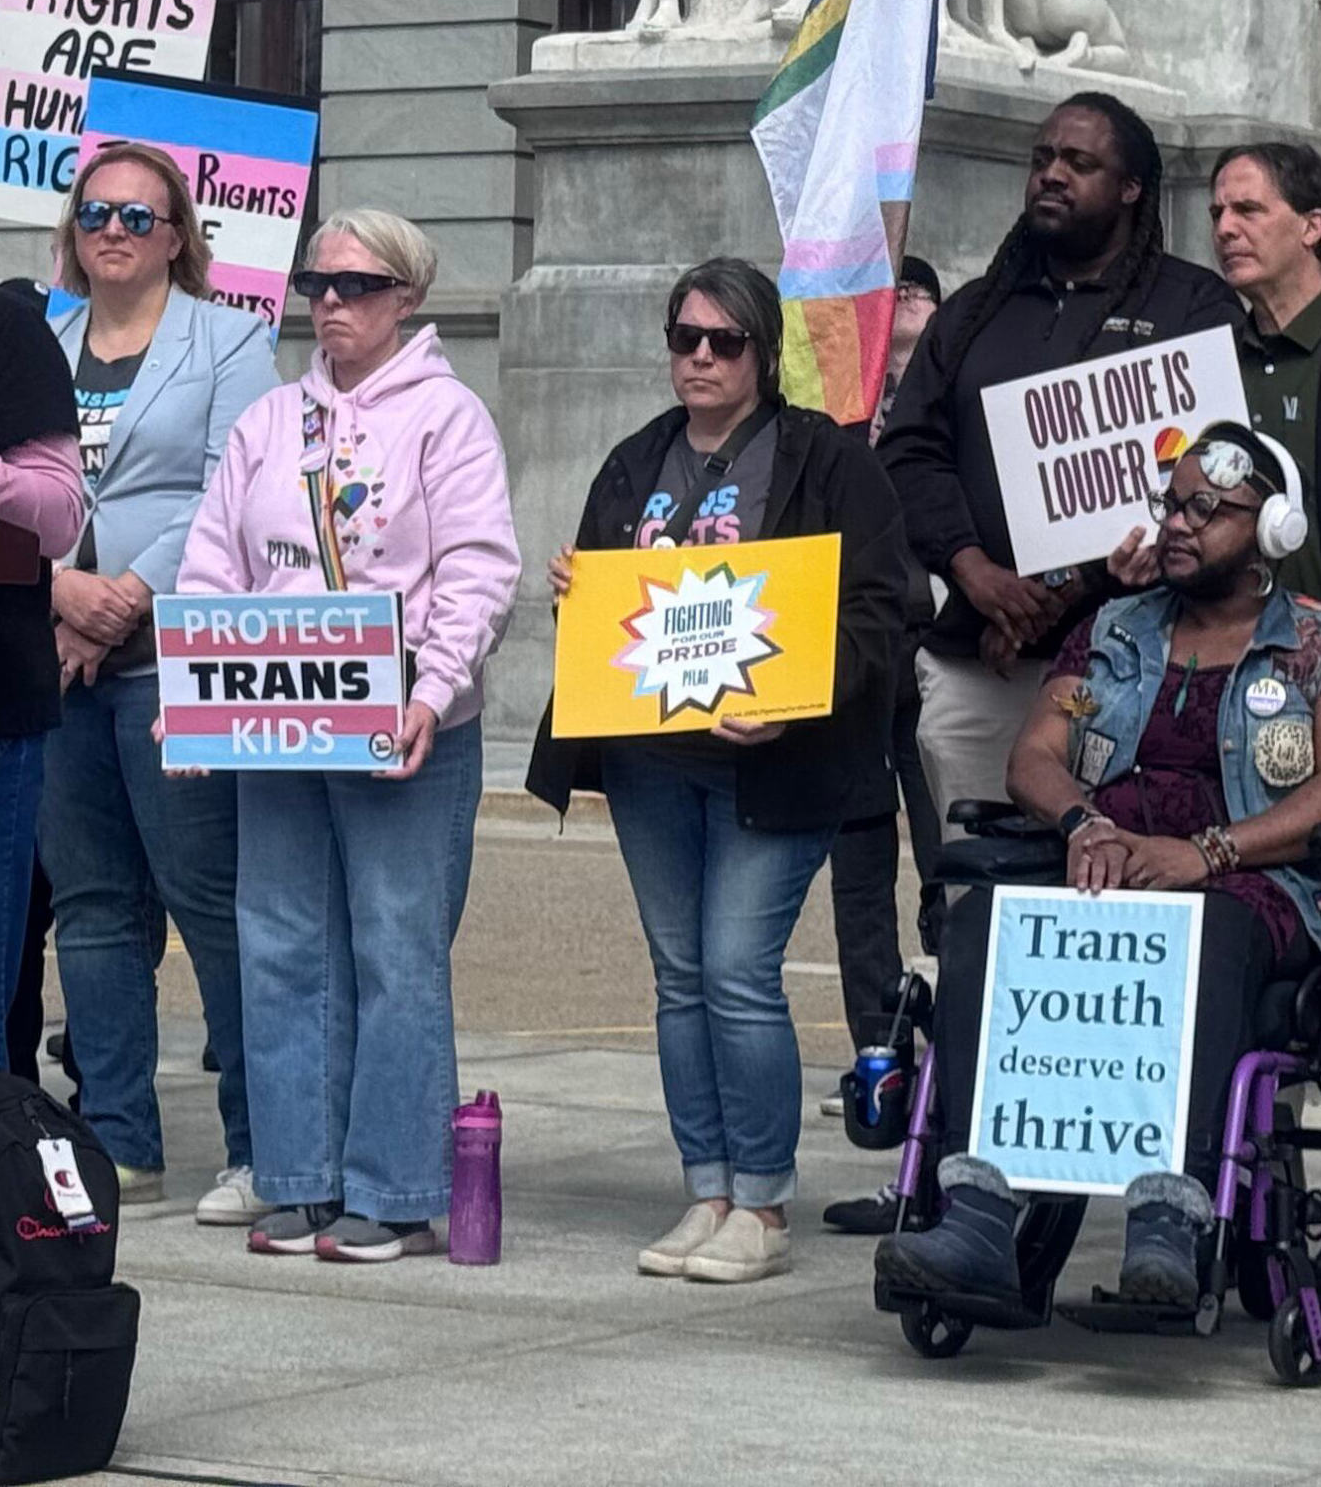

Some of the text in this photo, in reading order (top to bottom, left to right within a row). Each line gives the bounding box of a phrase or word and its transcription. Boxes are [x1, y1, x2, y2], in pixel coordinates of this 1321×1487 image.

[42, 28, 157, 80] ARE
[5, 79, 88, 135] HUM
[196, 153, 297, 219] RIGHTS
[1024, 349, 1198, 451] OUR LOVE IS
[1036, 438, 1152, 525] LOUDER
[182, 607, 370, 646] PROTECT
[664, 598, 733, 636] FIGHTING
[671, 629, 725, 646] FOR OUR
[657, 637, 738, 666] PRIDE
[188, 661, 371, 701] TRANS
[231, 716, 335, 756] KIDS
[1019, 913, 1168, 964] Trans
[1006, 979, 1165, 1036] youth
[998, 1045, 1166, 1084] deserve to
[990, 1097, 1163, 1159] thrive
